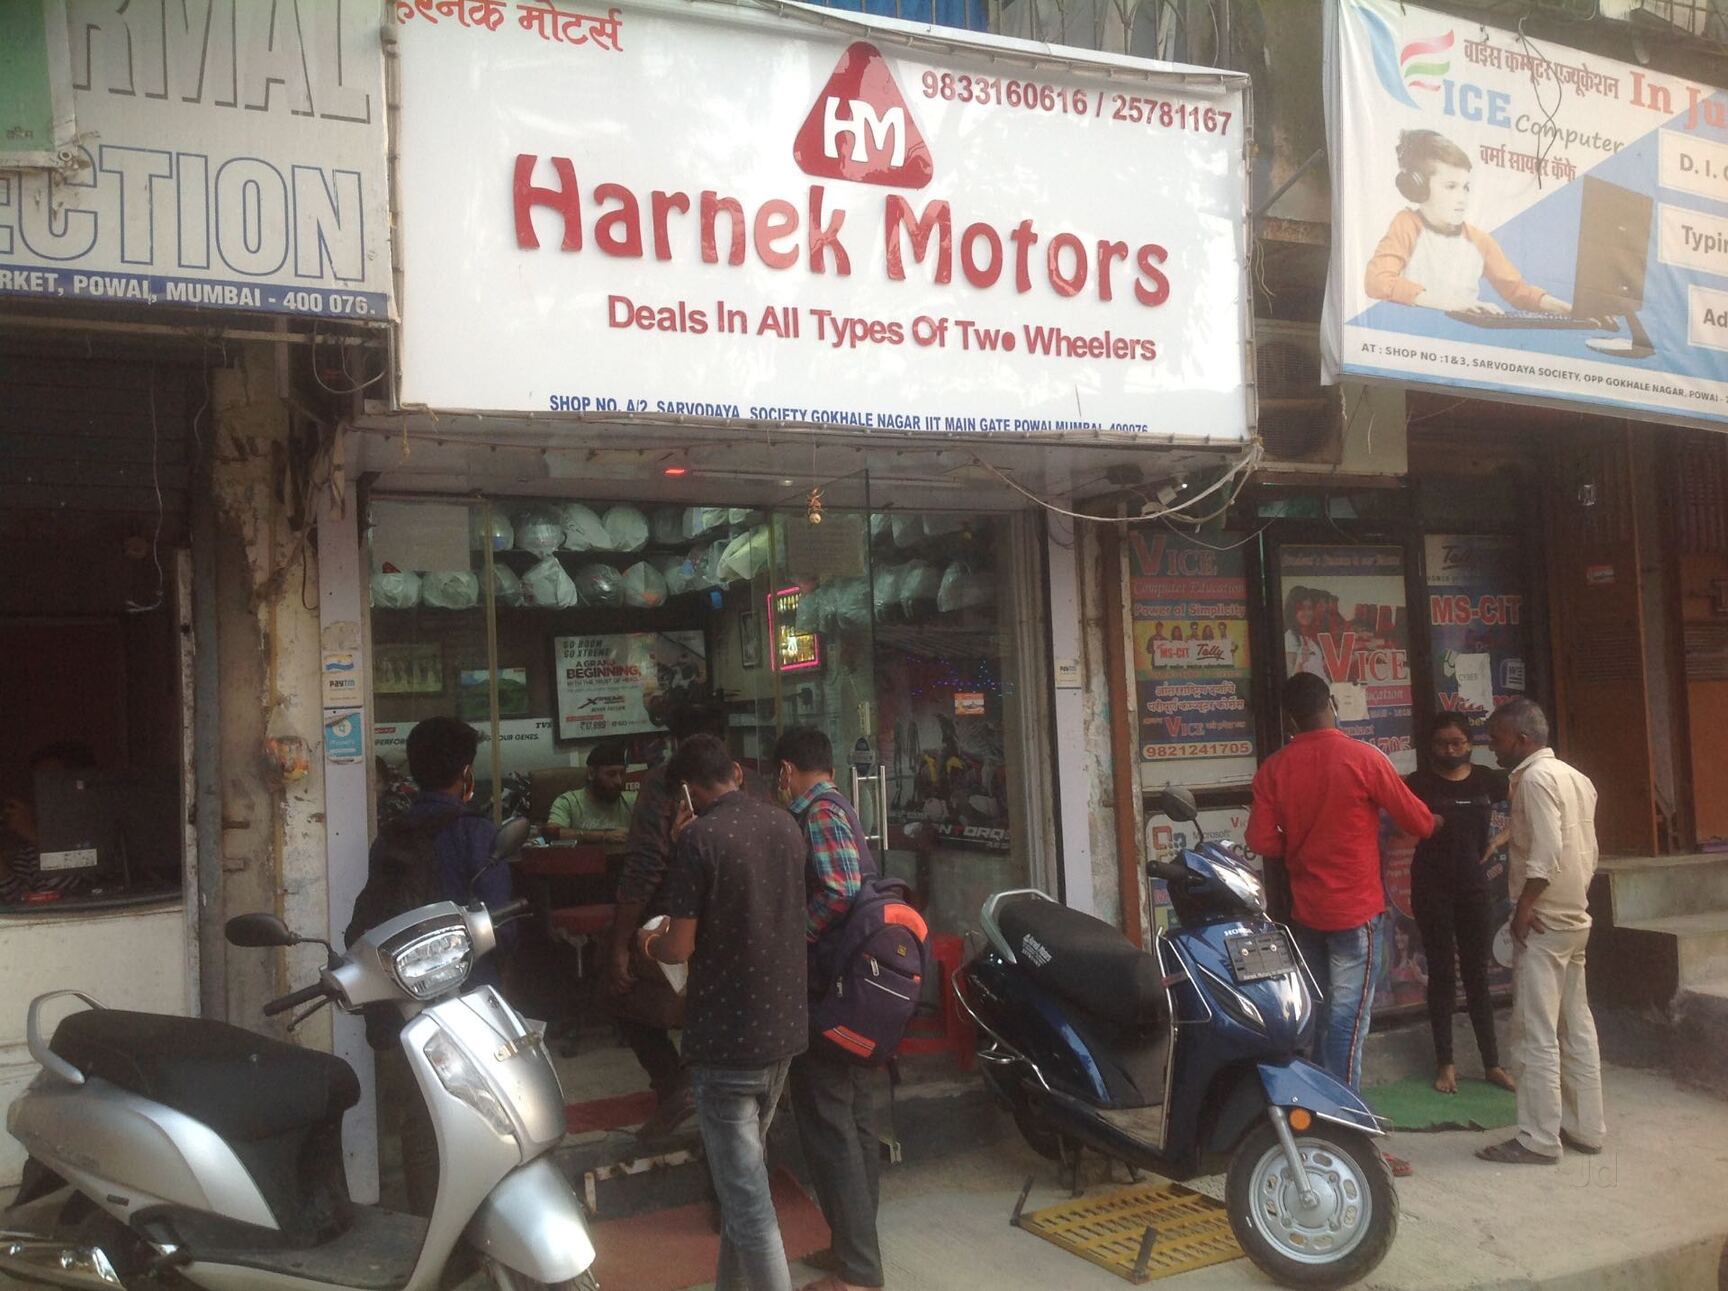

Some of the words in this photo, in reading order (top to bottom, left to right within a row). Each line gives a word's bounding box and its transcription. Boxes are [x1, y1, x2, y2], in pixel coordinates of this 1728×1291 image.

[516, 0, 623, 51] मोटर्स
[922, 70, 1088, 115] 9833160616
[1096, 92, 1104, 117] /
[1112, 94, 1232, 136] 25781167
[1629, 70, 1674, 115] In
[823, 97, 906, 168] HM
[1515, 114, 1625, 153] Computer
[513, 154, 851, 277] Harnek
[885, 193, 1171, 306] Motors
[166, 282, 261, 307] MUMBAI
[283, 291, 323, 312] 400
[608, 294, 709, 334] Deals
[717, 301, 748, 334] In
[756, 306, 800, 338] All
[809, 308, 904, 348] Types
[912, 316, 948, 348] Of
[955, 320, 1016, 351] Two
[1024, 324, 1157, 361] Wheelers
[1361, 343, 1376, 353] AT
[1386, 346, 1418, 359] SHOP
[1420, 352, 1437, 362] NO
[1472, 358, 1536, 375] SARVODAYA
[1538, 367, 1581, 382] SOCIETY,
[1584, 374, 1604, 384] OPP
[1605, 378, 1651, 392] GOKHALE
[549, 395, 591, 411] SHOP
[626, 400, 648, 411] A/2
[656, 401, 740, 417] SARVODAYA
[750, 407, 806, 422] SOCIETY
[811, 410, 873, 427] GOKHALE
[877, 414, 921, 430] NAGAR
[925, 417, 941, 430] IIT
[944, 417, 976, 431] MAIN
[979, 418, 1011, 431] GATE
[1014, 419, 1050, 431] POWAI
[1128, 530, 1218, 576] VICE
[1133, 604, 1171, 617] Power
[1173, 602, 1187, 617] of
[1188, 601, 1247, 619] Simplicity
[1134, 581, 1186, 598] Computer
[1429, 594, 1522, 626] MS-CIT
[1316, 631, 1408, 684] VICE
[1145, 742, 1250, 759] 9821241705
